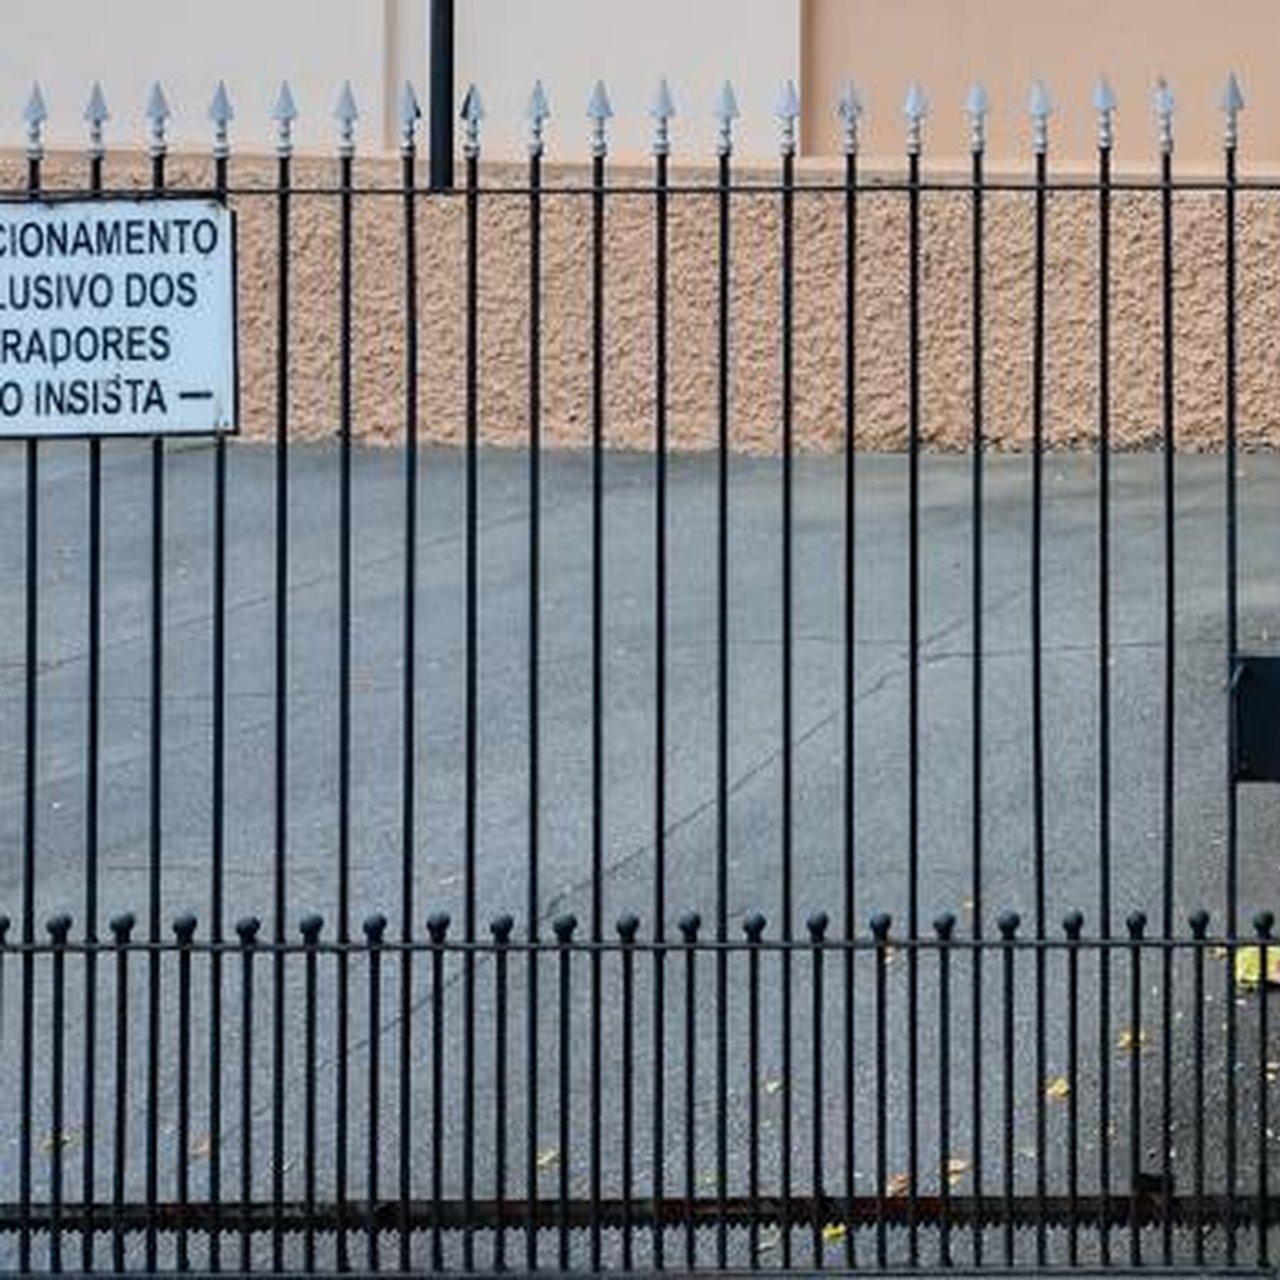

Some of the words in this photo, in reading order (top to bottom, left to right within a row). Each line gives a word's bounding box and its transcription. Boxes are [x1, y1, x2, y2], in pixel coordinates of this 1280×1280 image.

[0, 272, 113, 310] USIVO
[125, 272, 197, 307] DOS
[2, 325, 171, 364] RADORES
[35, 378, 168, 416] INSISTA
